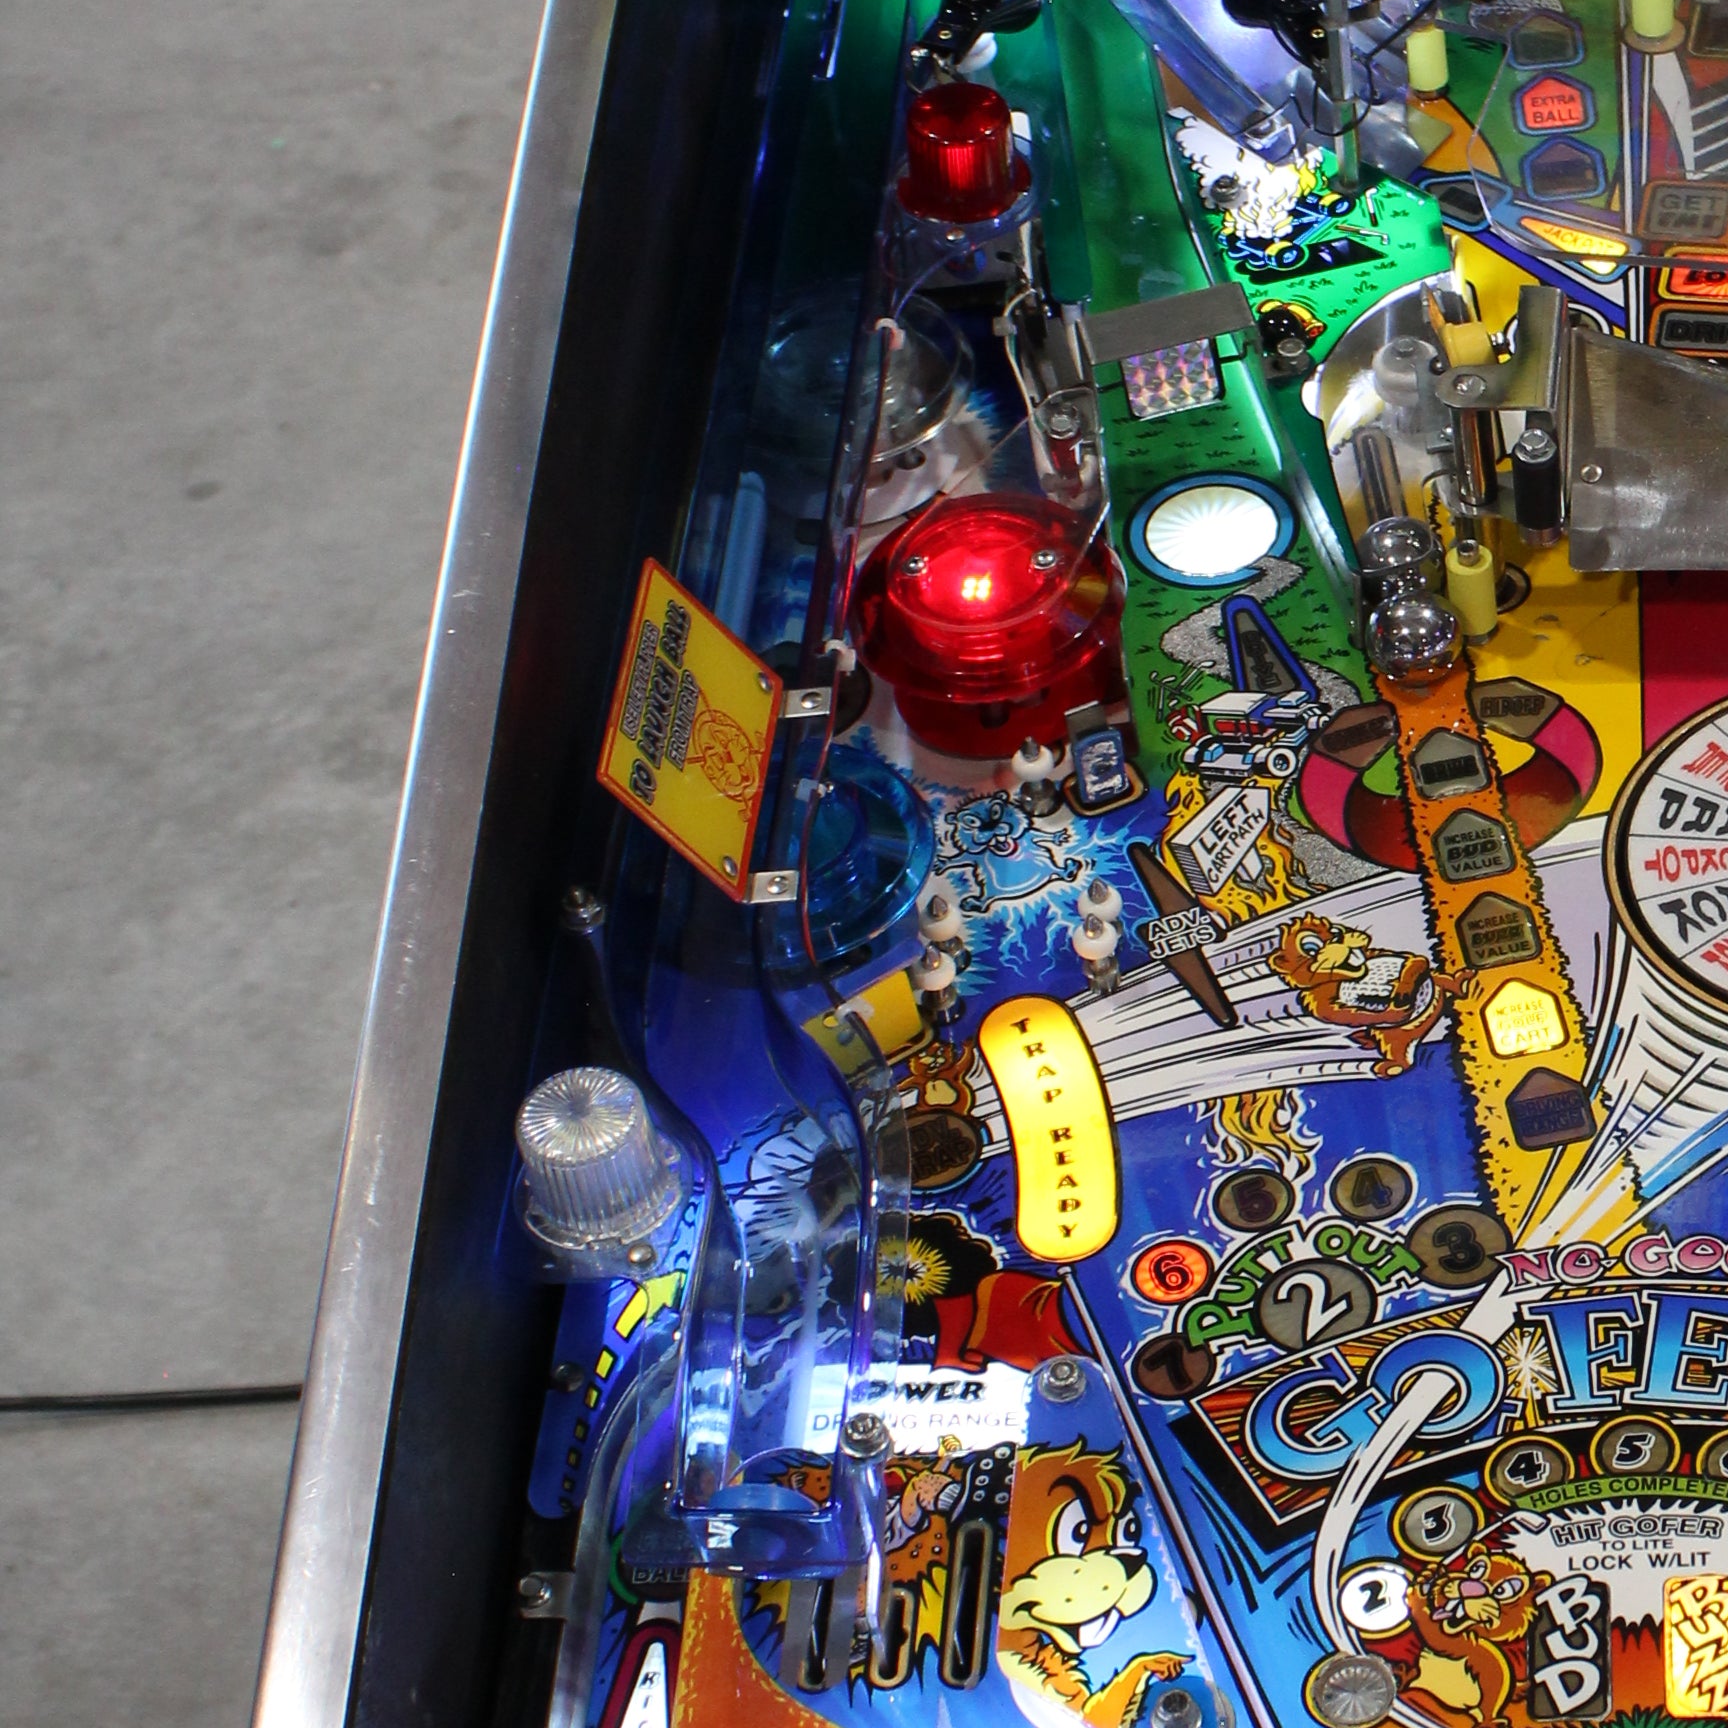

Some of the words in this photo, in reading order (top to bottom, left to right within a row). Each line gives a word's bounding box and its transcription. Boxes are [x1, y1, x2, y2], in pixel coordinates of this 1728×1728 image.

[1531, 95, 1576, 108] EXTRA
[1533, 109, 1579, 123] BALL
[1660, 193, 1723, 211] GET
[660, 600, 690, 669] BALL
[638, 656, 680, 769] LAUNCH
[630, 759, 657, 806] TO
[1199, 793, 1250, 856] LEFT
[1443, 827, 1494, 845] INCREASE
[1207, 843, 1235, 884] CART
[1228, 808, 1265, 847] PATH
[1446, 838, 1501, 860] BUD
[1450, 855, 1504, 873] VALUE
[1149, 906, 1212, 942] ADV.
[1466, 912, 1521, 931] INCREASE
[1150, 924, 1217, 960] JETS
[1475, 939, 1532, 959] VALUE
[1185, 1228, 1295, 1348] PUTT
[1313, 1221, 1423, 1285] OUT
[1271, 1272, 1349, 1344] 2
[928, 1410, 1020, 1429] RANGE
[1528, 1478, 1604, 1510] HOLES
[1551, 1517, 1607, 1546] HIT
[1608, 1513, 1726, 1540] GOFER
[1599, 1539, 1628, 1553] TO
[1632, 1536, 1675, 1552] LITE
[1567, 1551, 1633, 1572] LOCK
[1647, 1550, 1711, 1570] W/LIT
[1535, 1575, 1603, 1716] BUD
